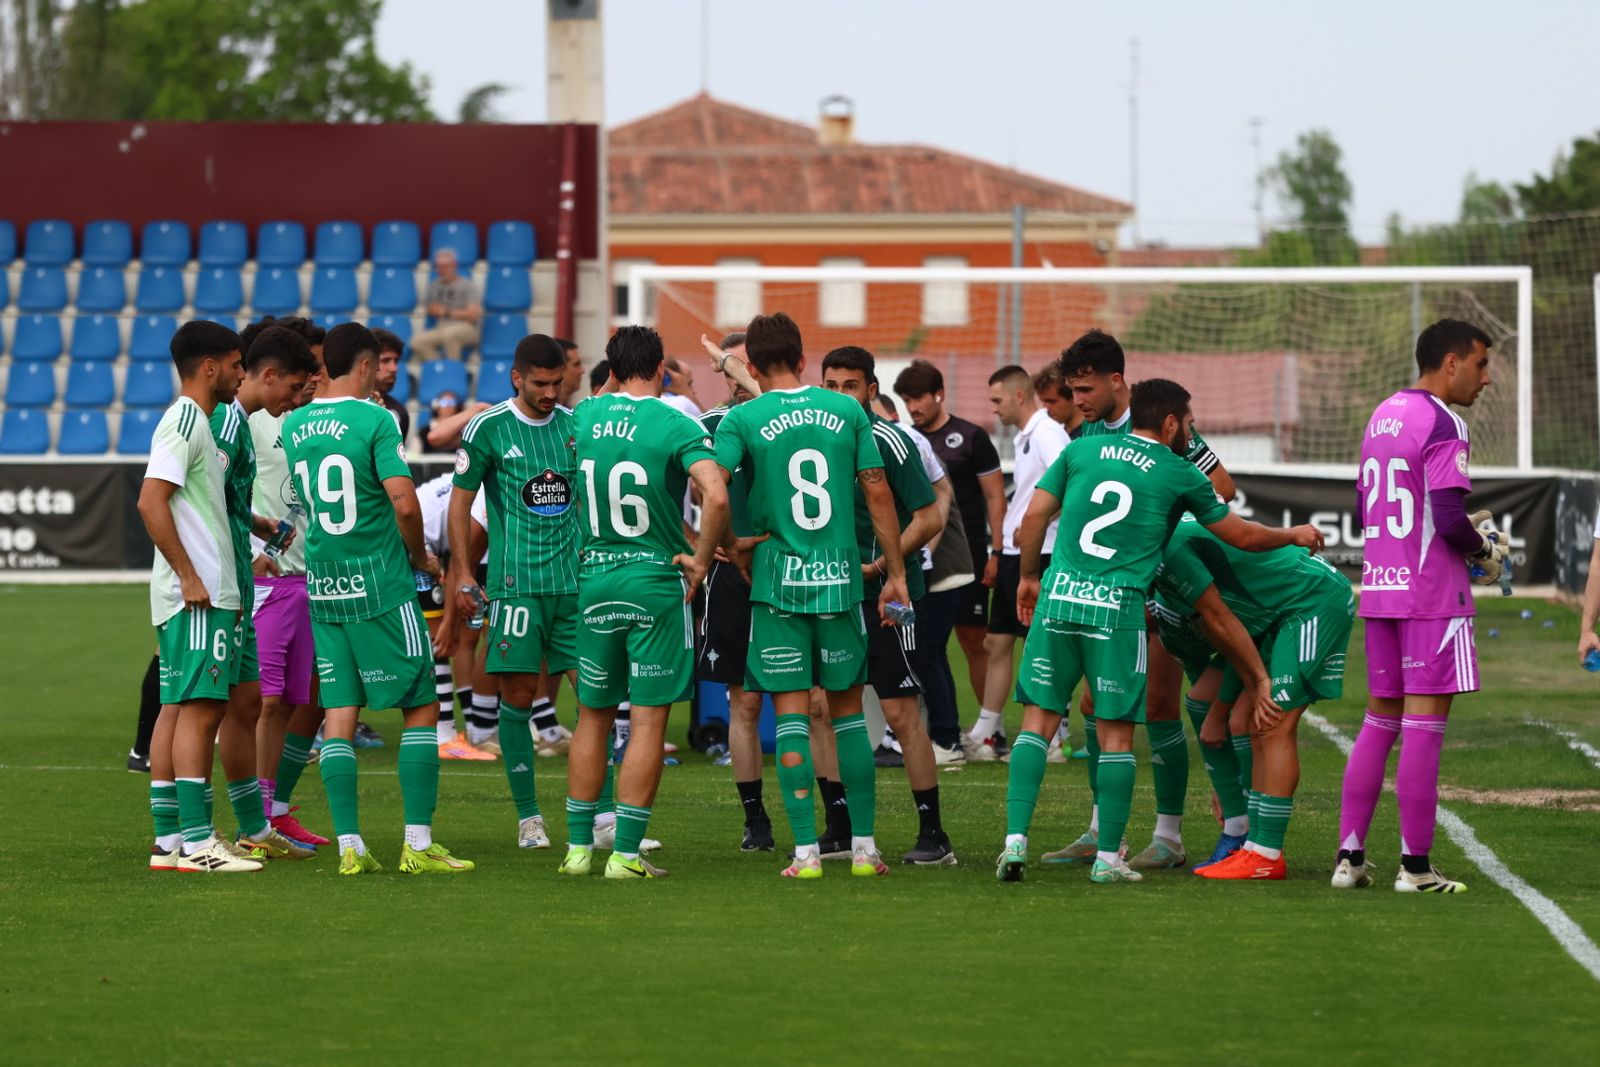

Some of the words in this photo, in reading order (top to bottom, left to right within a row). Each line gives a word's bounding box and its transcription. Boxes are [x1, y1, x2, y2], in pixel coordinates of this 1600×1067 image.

[291, 419, 349, 448] AZKUNE
[592, 417, 637, 441] SAÚL
[760, 409, 845, 441] GOROSTIDI
[1370, 418, 1403, 438] LUCAS
[1100, 445, 1156, 472] MIGUE
[294, 454, 357, 536] 19
[531, 482, 566, 494] Estrella
[532, 492, 566, 505] Galicia
[579, 459, 650, 537] 16
[788, 448, 832, 530] 8
[1363, 457, 1414, 539] 25
[1079, 480, 1133, 560] 2
[784, 555, 850, 580] Prace
[1051, 572, 1123, 604] Prace
[503, 605, 529, 637] 10
[584, 612, 654, 625] integralmotion
[213, 629, 227, 661] 6
[363, 669, 384, 677] XUNTA
[372, 674, 398, 683] GALICIA
[648, 668, 674, 677] GALICIA
